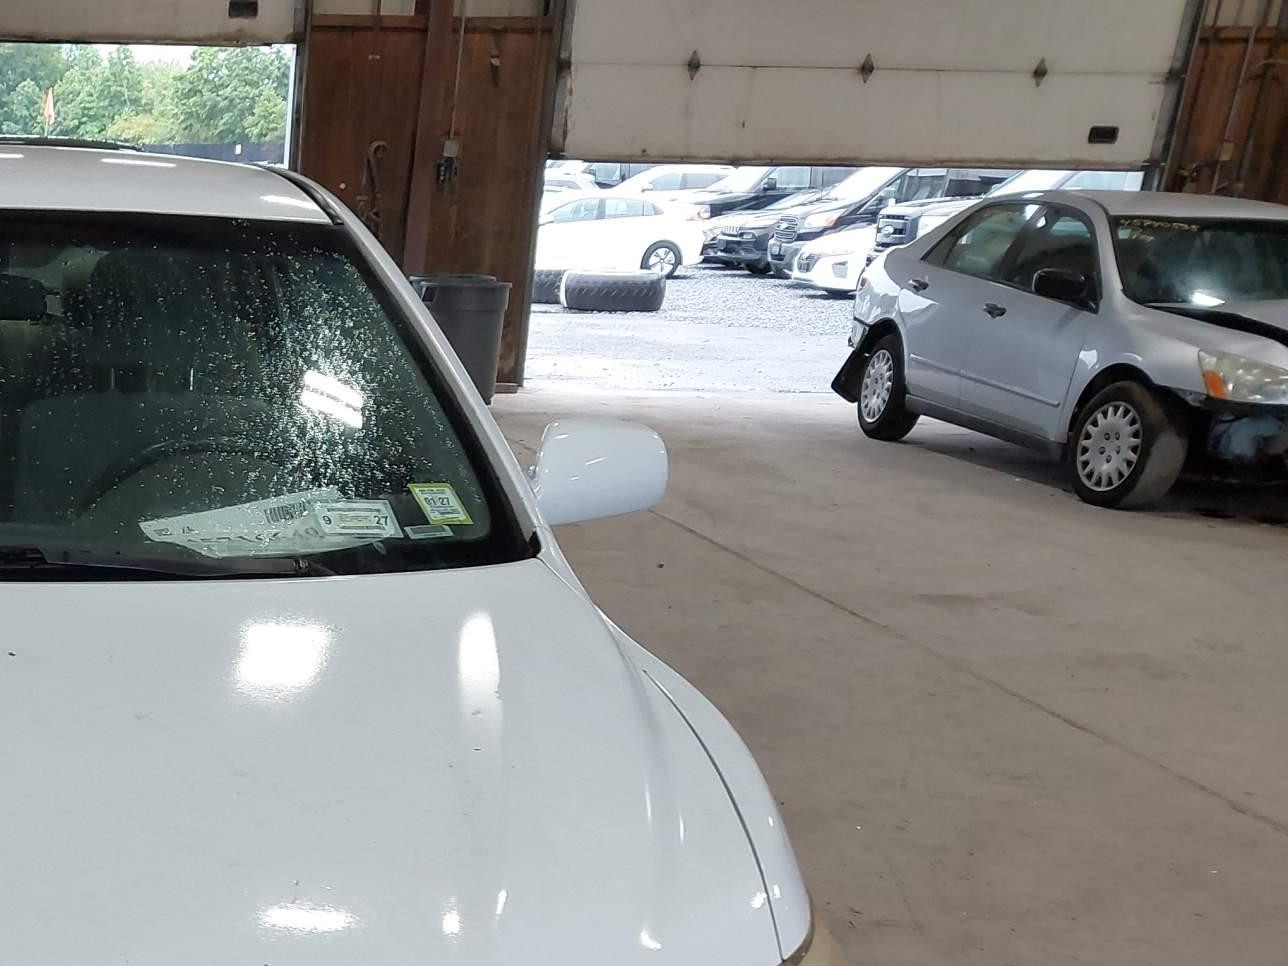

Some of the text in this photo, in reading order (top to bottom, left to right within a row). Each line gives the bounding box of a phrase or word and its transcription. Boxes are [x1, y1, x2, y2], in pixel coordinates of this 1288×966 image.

[423, 496, 451, 506] 01 27
[322, 515, 333, 526] 9
[373, 515, 389, 526] 27
